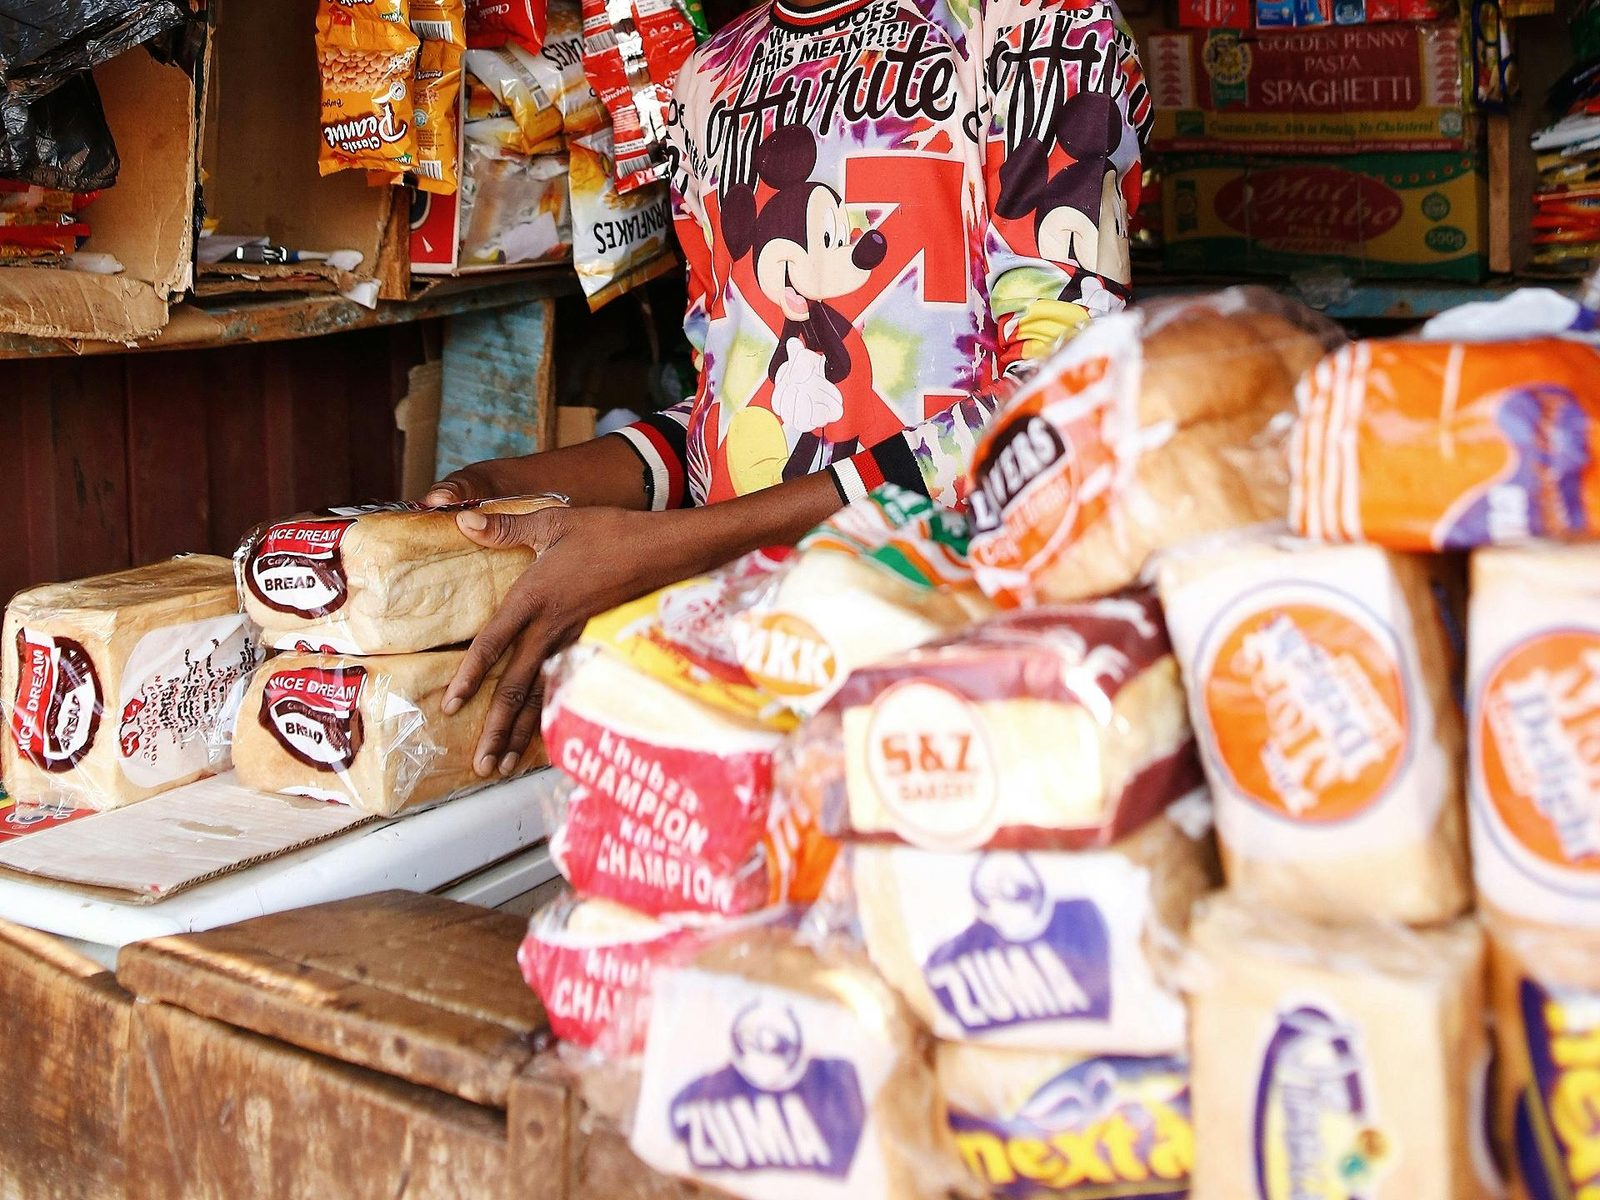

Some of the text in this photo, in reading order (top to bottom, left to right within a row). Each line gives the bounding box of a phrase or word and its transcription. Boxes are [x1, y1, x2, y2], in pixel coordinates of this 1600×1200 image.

[1342, 31, 1409, 52] PENNY
[755, 47, 795, 71] THIS
[1303, 55, 1363, 74] PASTA
[1261, 77, 1412, 106] SPAGHETTI
[323, 102, 407, 147] Peanut
[341, 135, 380, 154] Classic
[295, 527, 341, 543] DREAM
[263, 574, 317, 592] BREAD
[26, 648, 46, 713] DREAM
[269, 676, 357, 701] NICE DREAM
[561, 737, 710, 855] CHAMPION
[596, 836, 734, 914] CHAMPION
[929, 940, 1094, 1029] ZUMA
[675, 1095, 832, 1170] ZUMA
